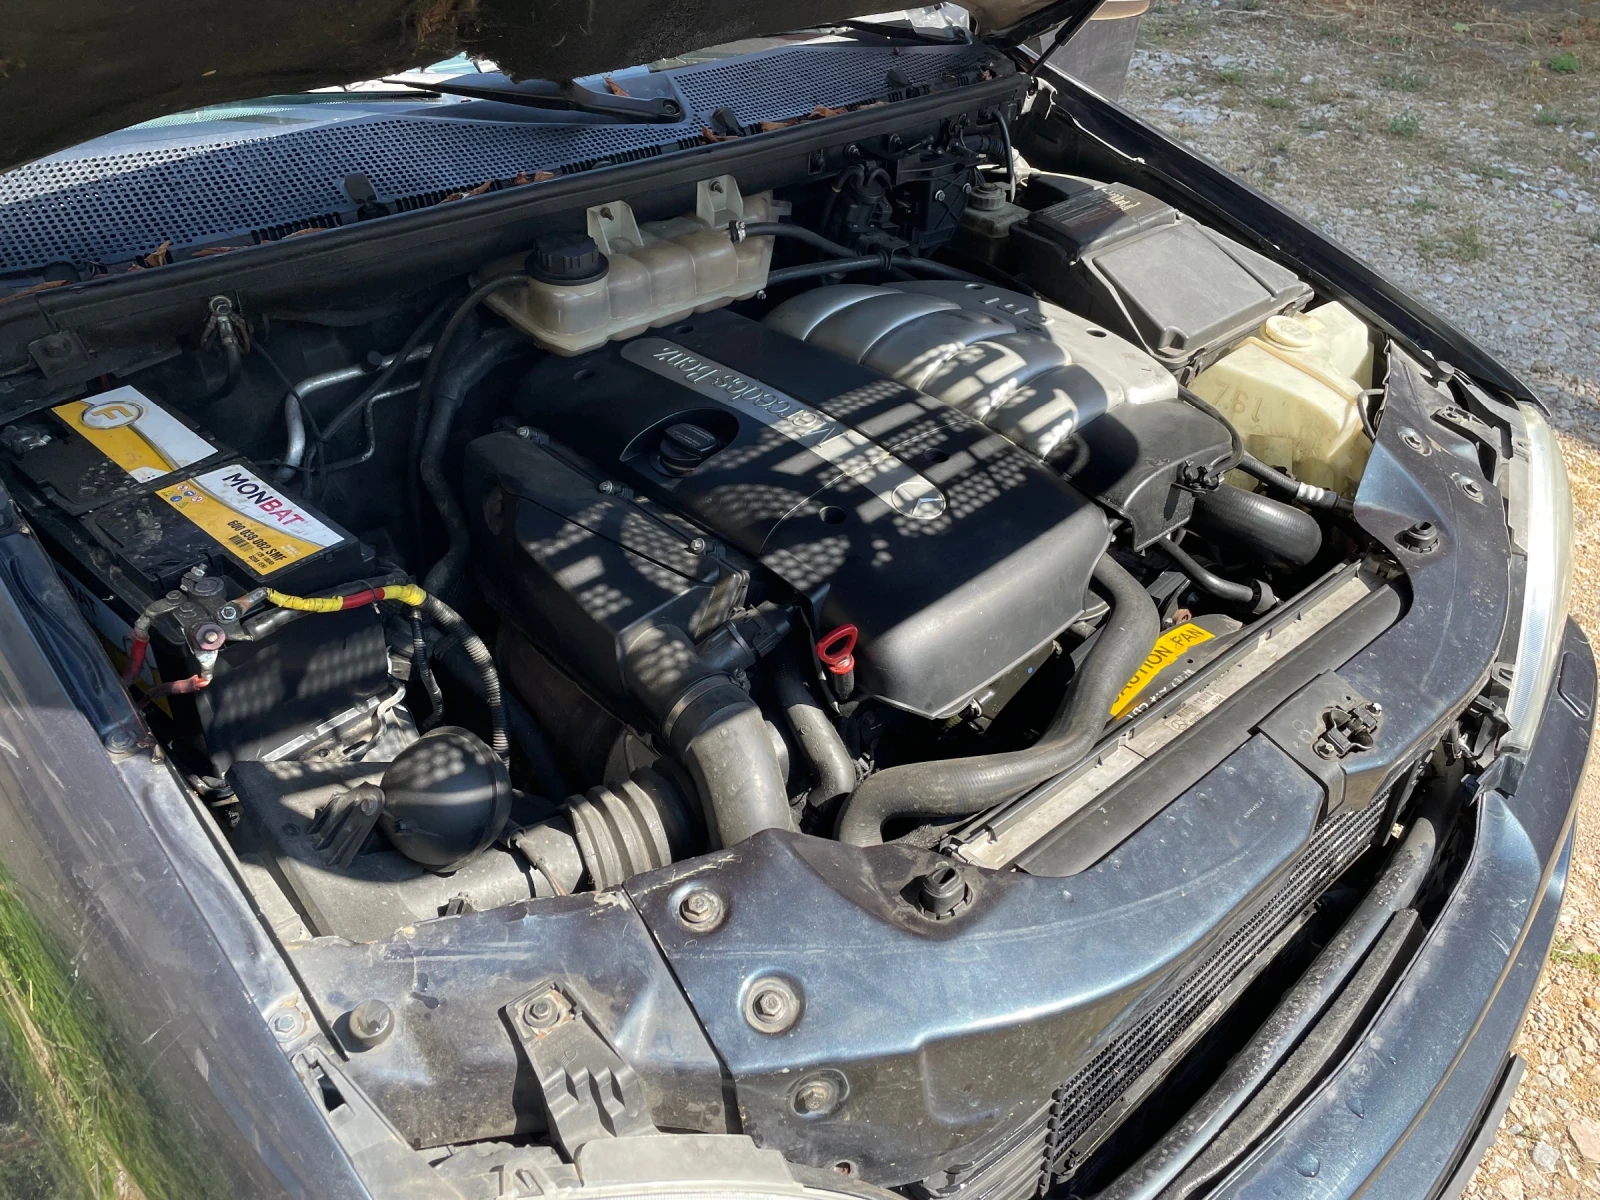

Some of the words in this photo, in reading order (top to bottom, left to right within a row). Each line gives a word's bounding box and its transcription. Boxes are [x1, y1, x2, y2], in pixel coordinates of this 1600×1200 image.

[652, 346, 849, 449] Mercedes-Benz
[222, 472, 305, 526] MONBAT
[266, 547, 287, 562] SMF
[1170, 628, 1205, 647] FAN
